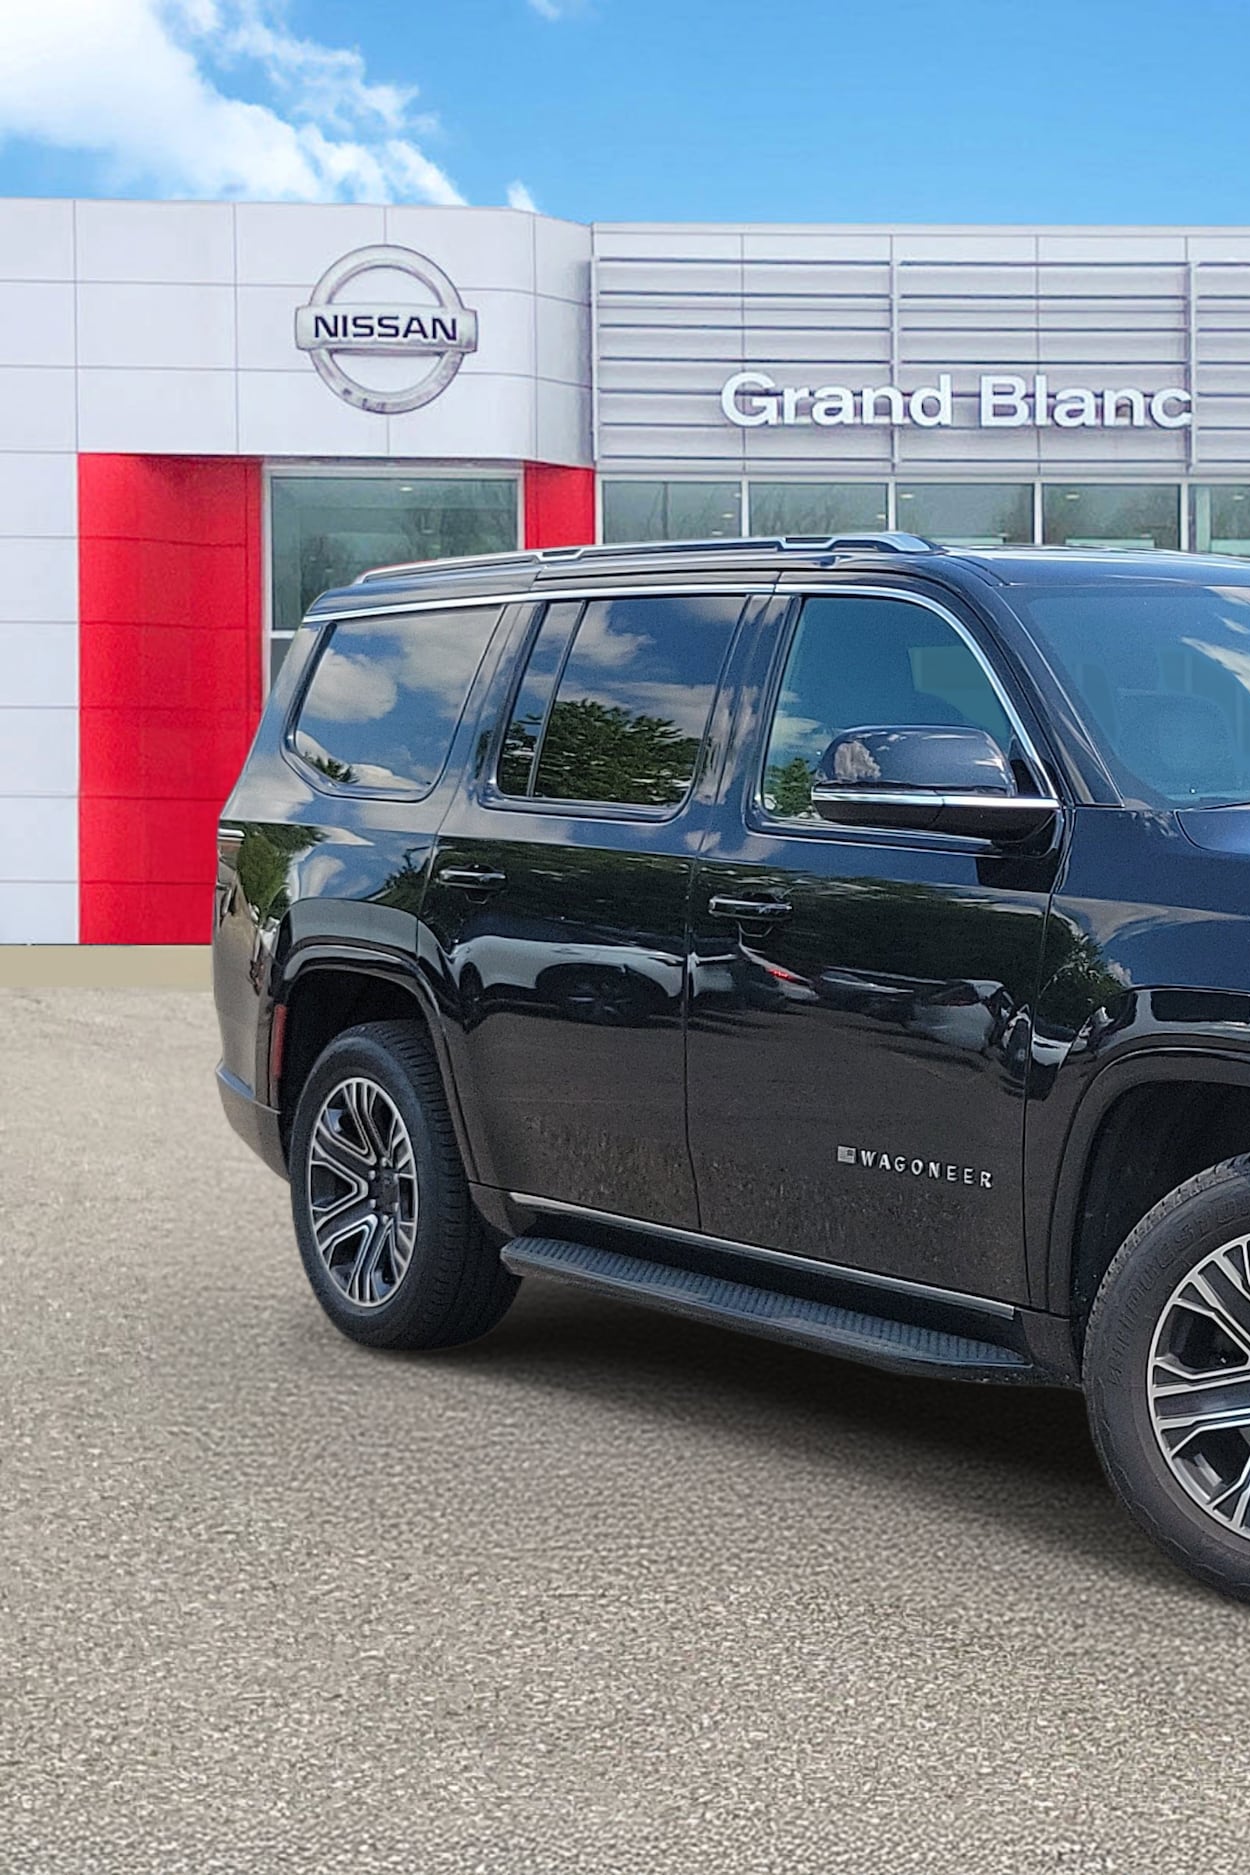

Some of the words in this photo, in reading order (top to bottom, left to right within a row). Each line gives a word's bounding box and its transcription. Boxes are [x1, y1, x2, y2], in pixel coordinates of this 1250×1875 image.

[314, 314, 457, 341] NISSAN
[720, 371, 952, 428] Grand
[978, 373, 1193, 428] Blanc
[860, 1150, 992, 1189] WAGONEER
